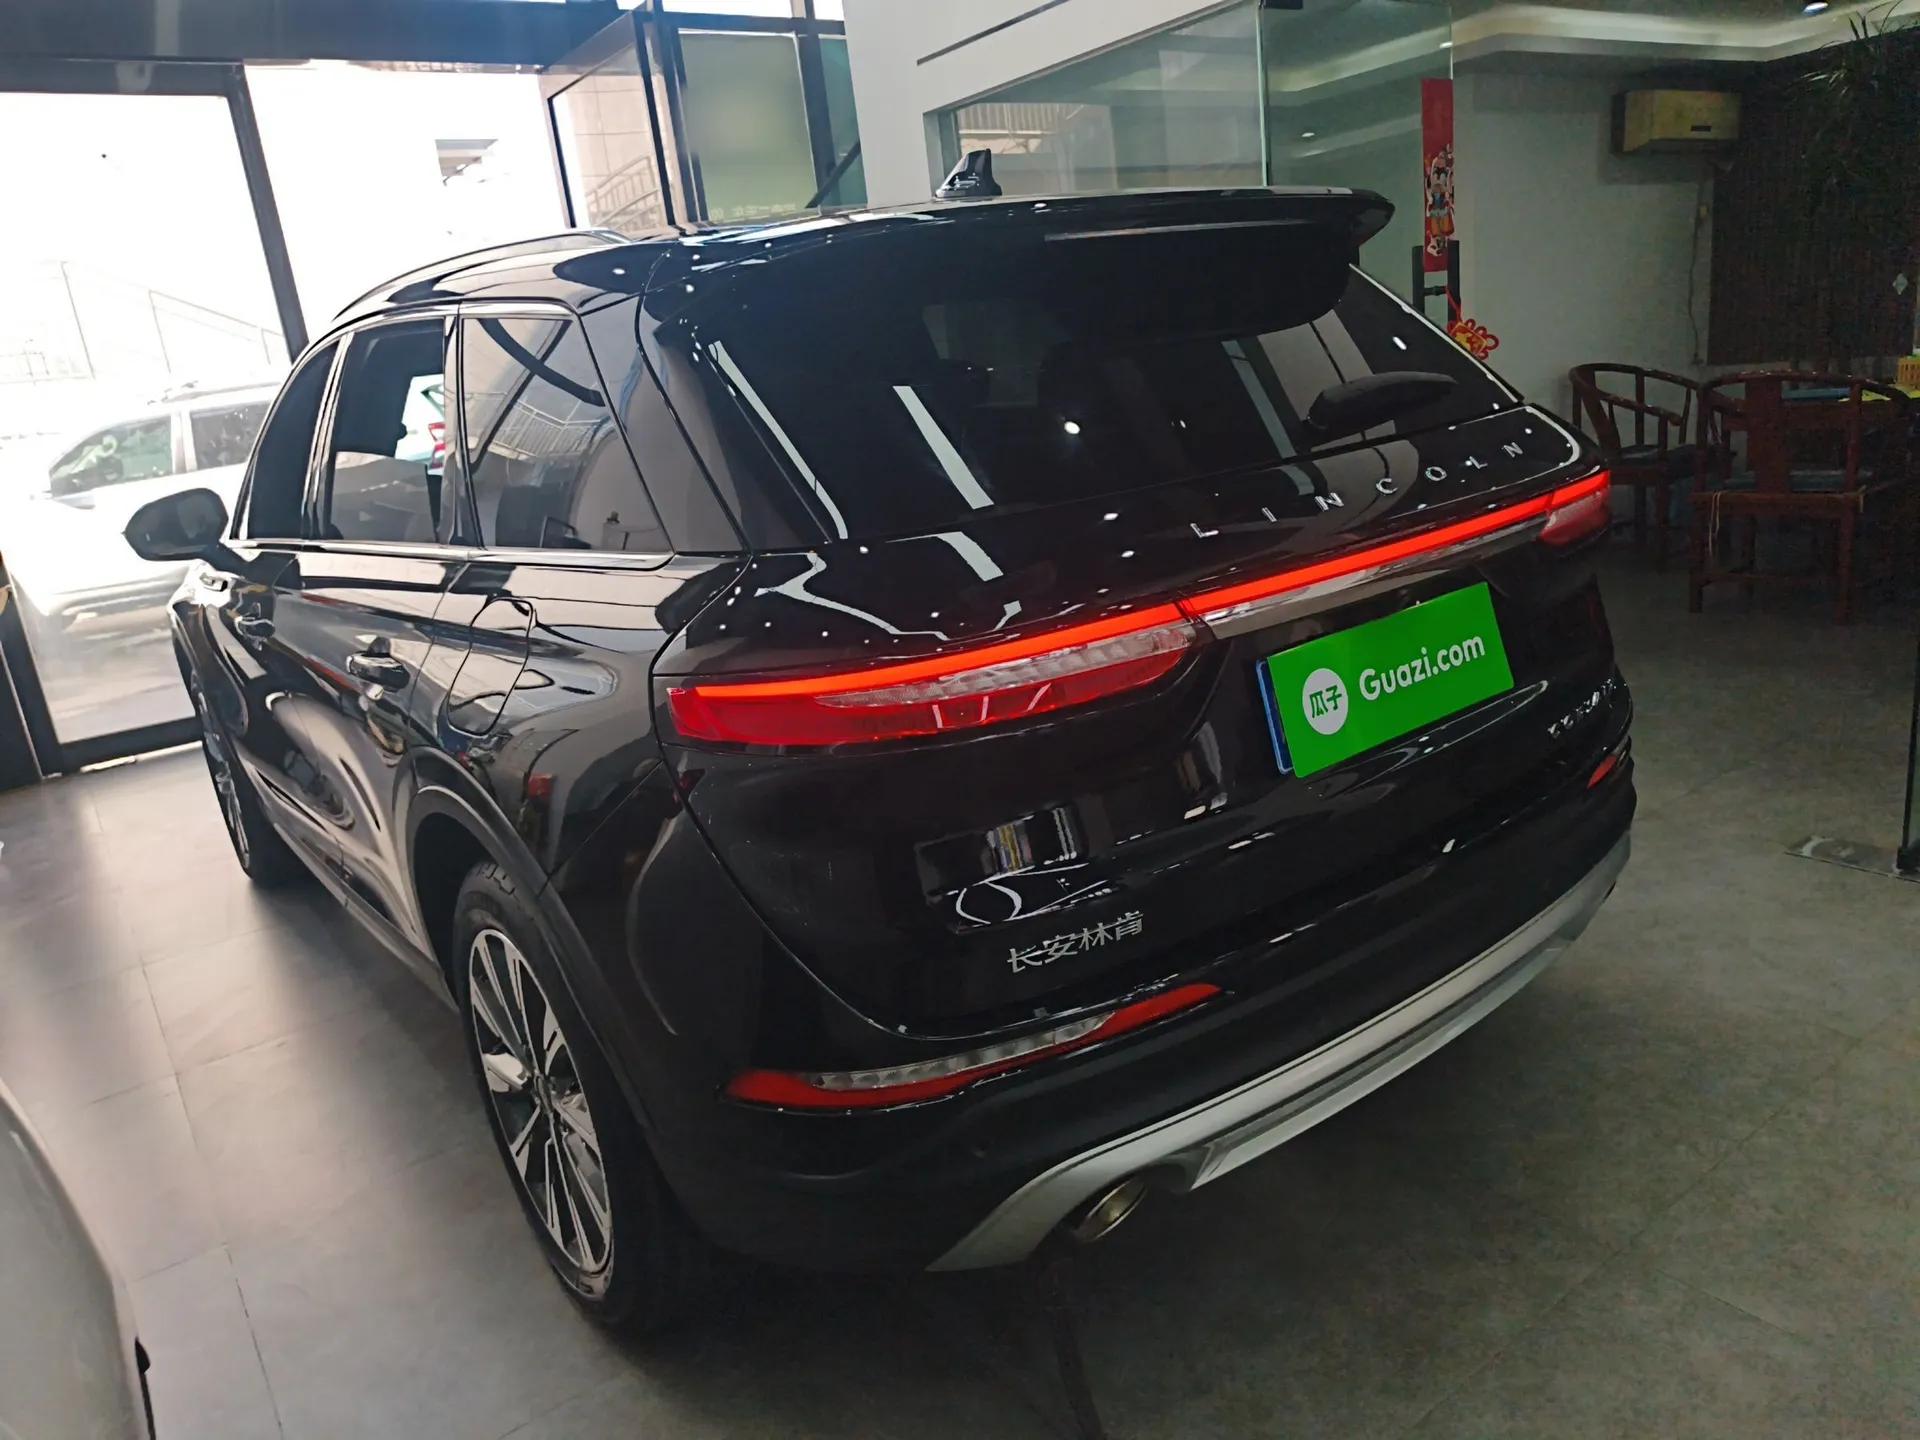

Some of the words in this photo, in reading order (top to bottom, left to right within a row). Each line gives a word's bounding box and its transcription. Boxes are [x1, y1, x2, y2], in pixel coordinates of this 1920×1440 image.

[1189, 441, 1524, 540] LINCOLN
[1006, 910, 1144, 974] 长安林肯
